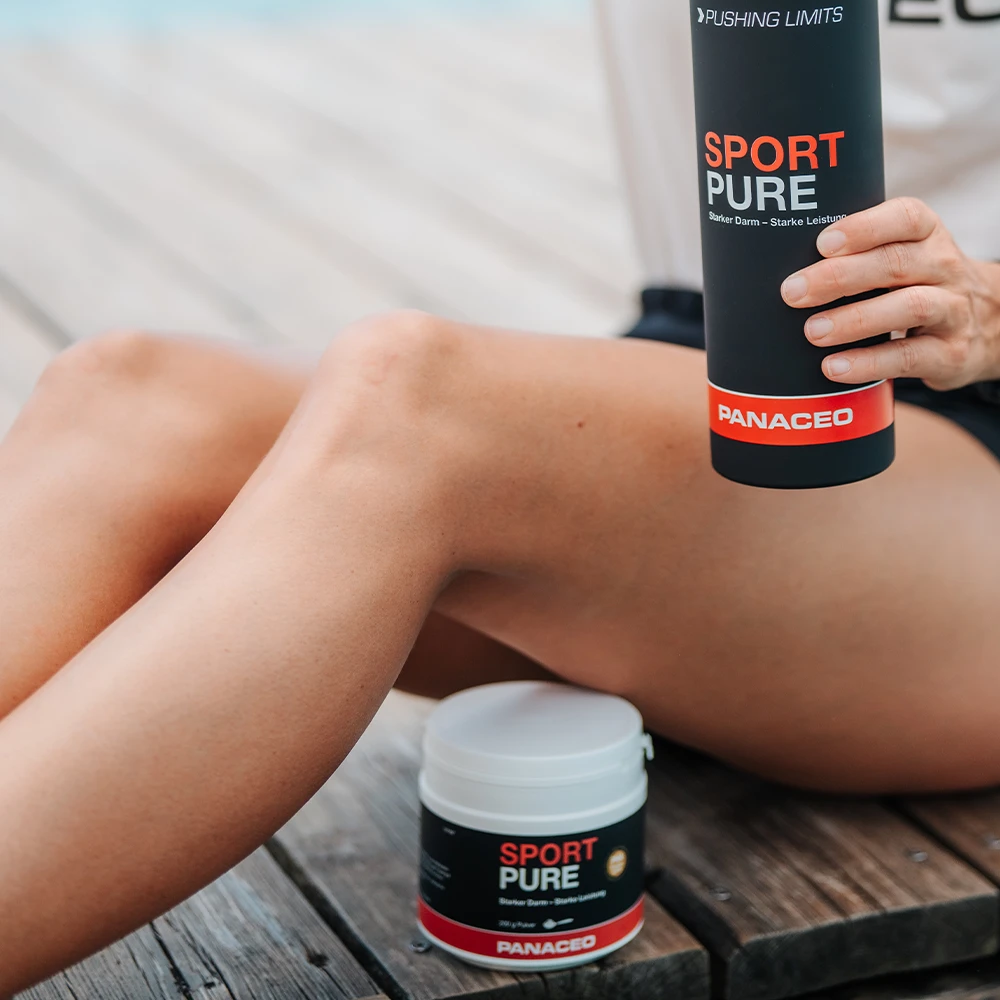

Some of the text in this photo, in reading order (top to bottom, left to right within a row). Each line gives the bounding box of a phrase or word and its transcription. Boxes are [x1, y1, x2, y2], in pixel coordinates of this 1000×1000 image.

[705, 6, 844, 28] PUSHING LIMITS
[704, 131, 845, 172] SPORT
[706, 170, 818, 212] PURE
[708, 211, 733, 224] Starker
[735, 216, 760, 226] Darm
[770, 217, 804, 227] Starke
[718, 404, 854, 430] PANACEO
[500, 837, 599, 866] SPORT
[499, 864, 580, 892] PURE
[496, 935, 597, 955] PANACEO
